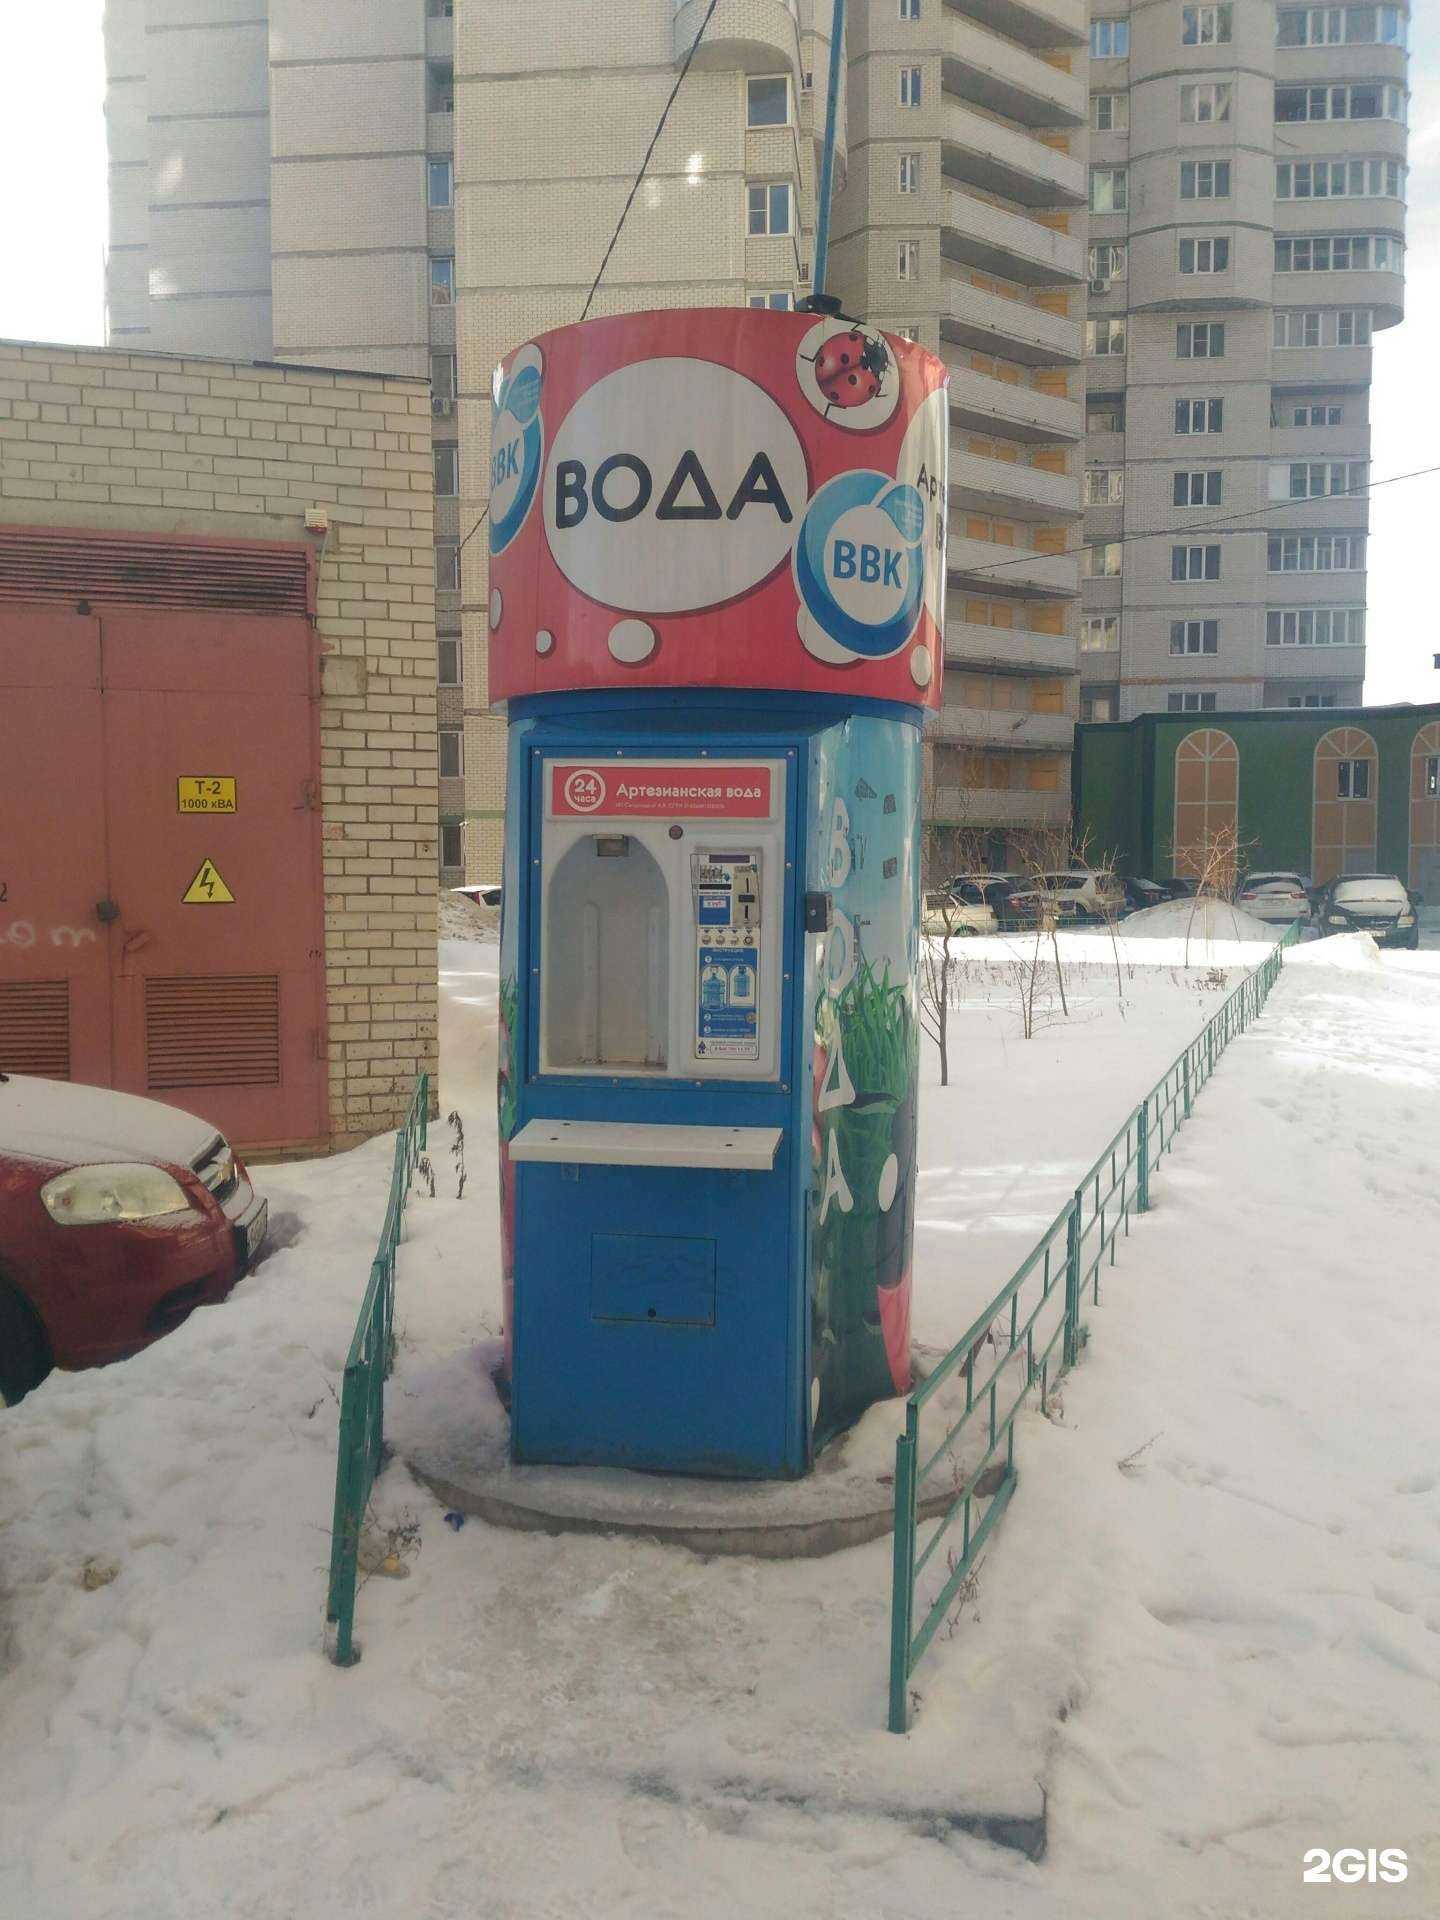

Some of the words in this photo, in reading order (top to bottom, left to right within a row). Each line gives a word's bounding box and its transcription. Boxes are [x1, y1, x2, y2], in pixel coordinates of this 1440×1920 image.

[555, 449, 794, 530] ВОДА
[833, 539, 903, 589] ВВК
[194, 780, 222, 795] Т-2
[574, 778, 597, 794] 24
[616, 783, 722, 799] Артезианская
[726, 787, 761, 798] вода
[181, 799, 208, 809] 1000
[573, 795, 597, 803] часа
